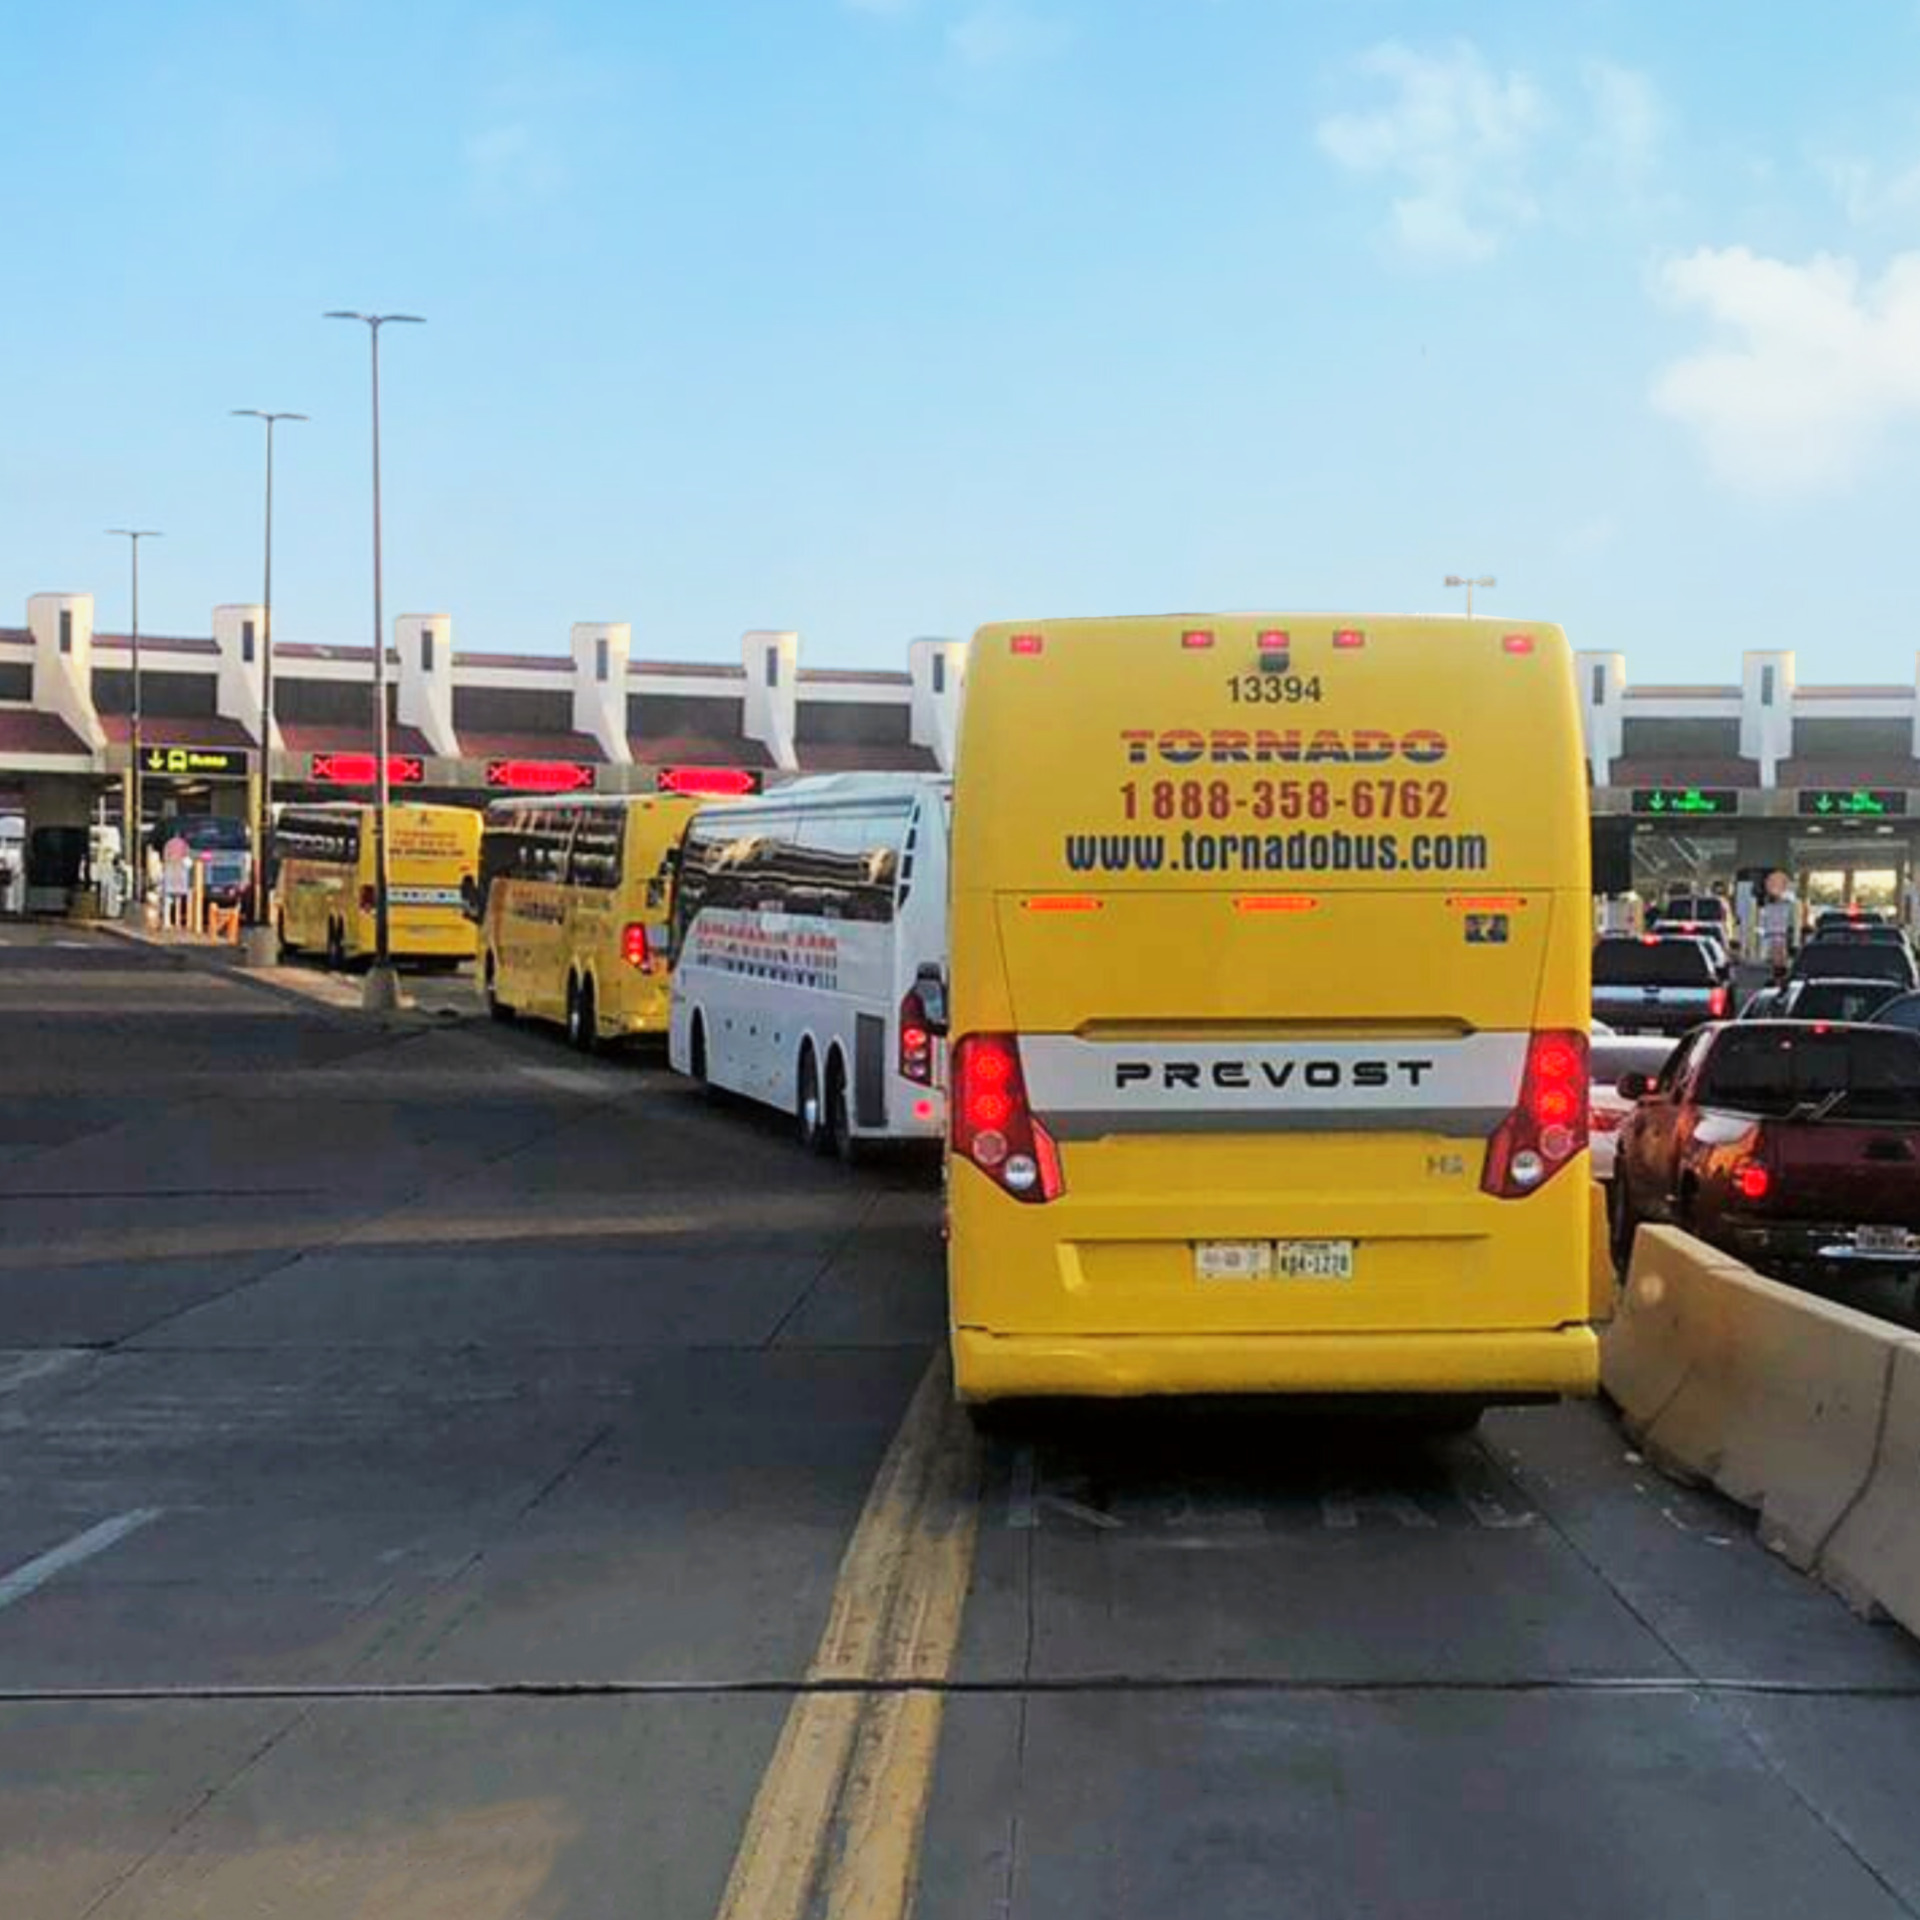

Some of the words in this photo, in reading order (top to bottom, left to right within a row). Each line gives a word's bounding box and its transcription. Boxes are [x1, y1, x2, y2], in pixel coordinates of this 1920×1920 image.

[1226, 676, 1322, 703] 13394
[1120, 729, 1448, 763] TORNADO
[1152, 779, 1449, 820] 888-358-6762
[1065, 831, 1488, 871] www.tornadobus.com
[1115, 1061, 1433, 1089] PREVOST
